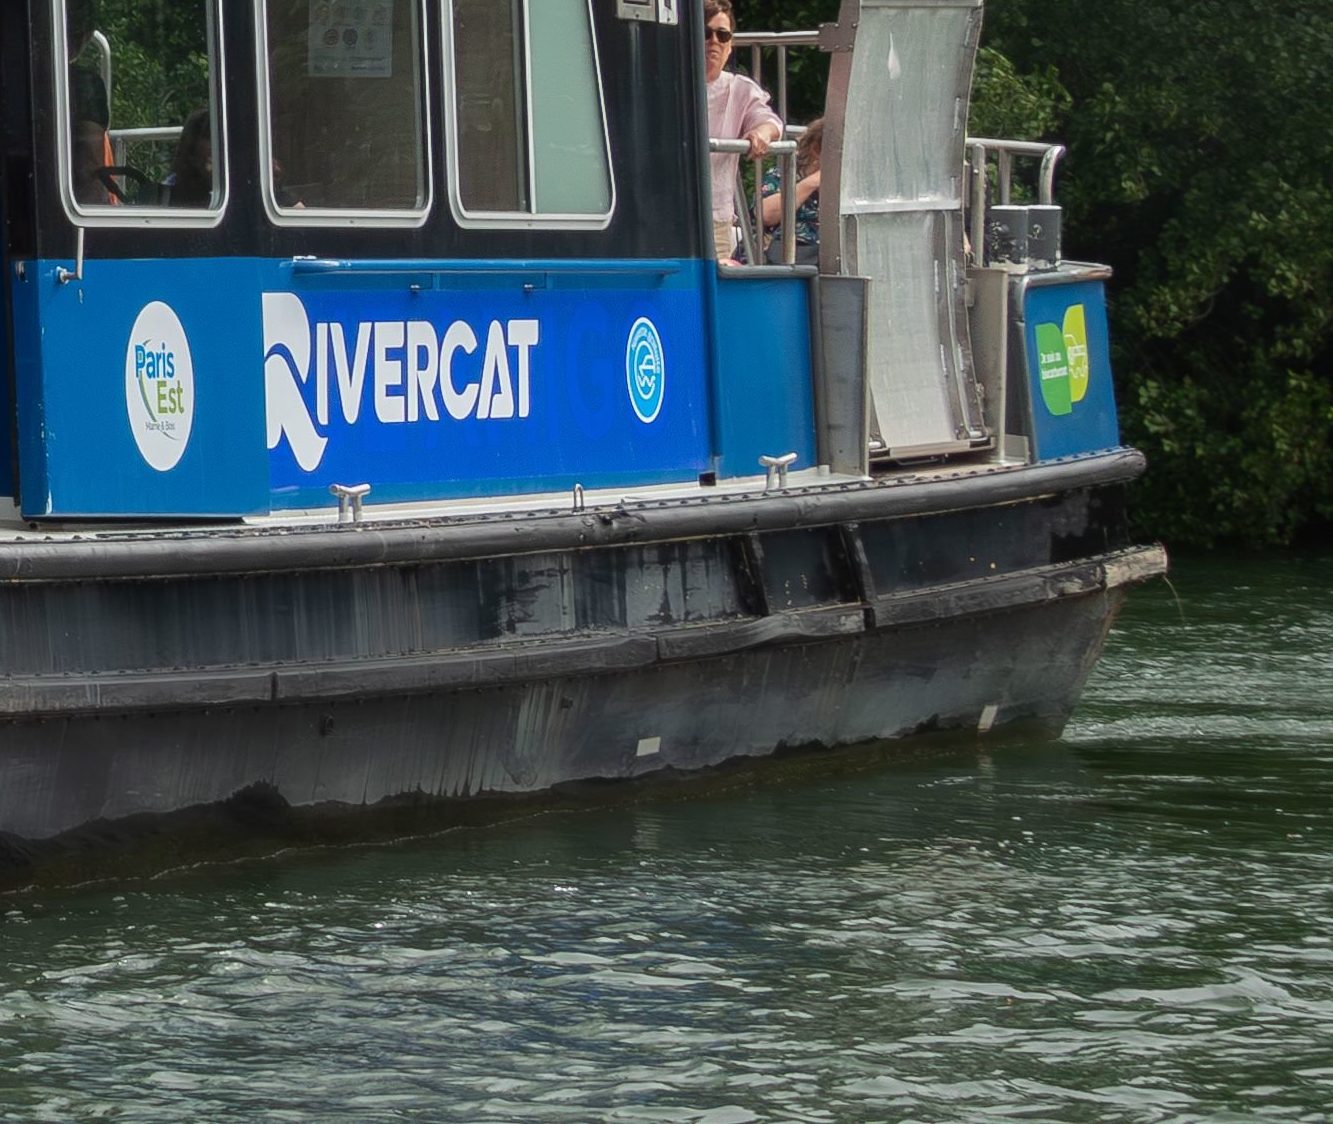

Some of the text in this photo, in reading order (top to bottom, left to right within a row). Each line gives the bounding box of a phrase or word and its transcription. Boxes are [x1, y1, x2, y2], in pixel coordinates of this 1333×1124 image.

[134, 342, 175, 379] Paris
[157, 379, 185, 415] Est
[261, 291, 540, 472] RIVERCAT
